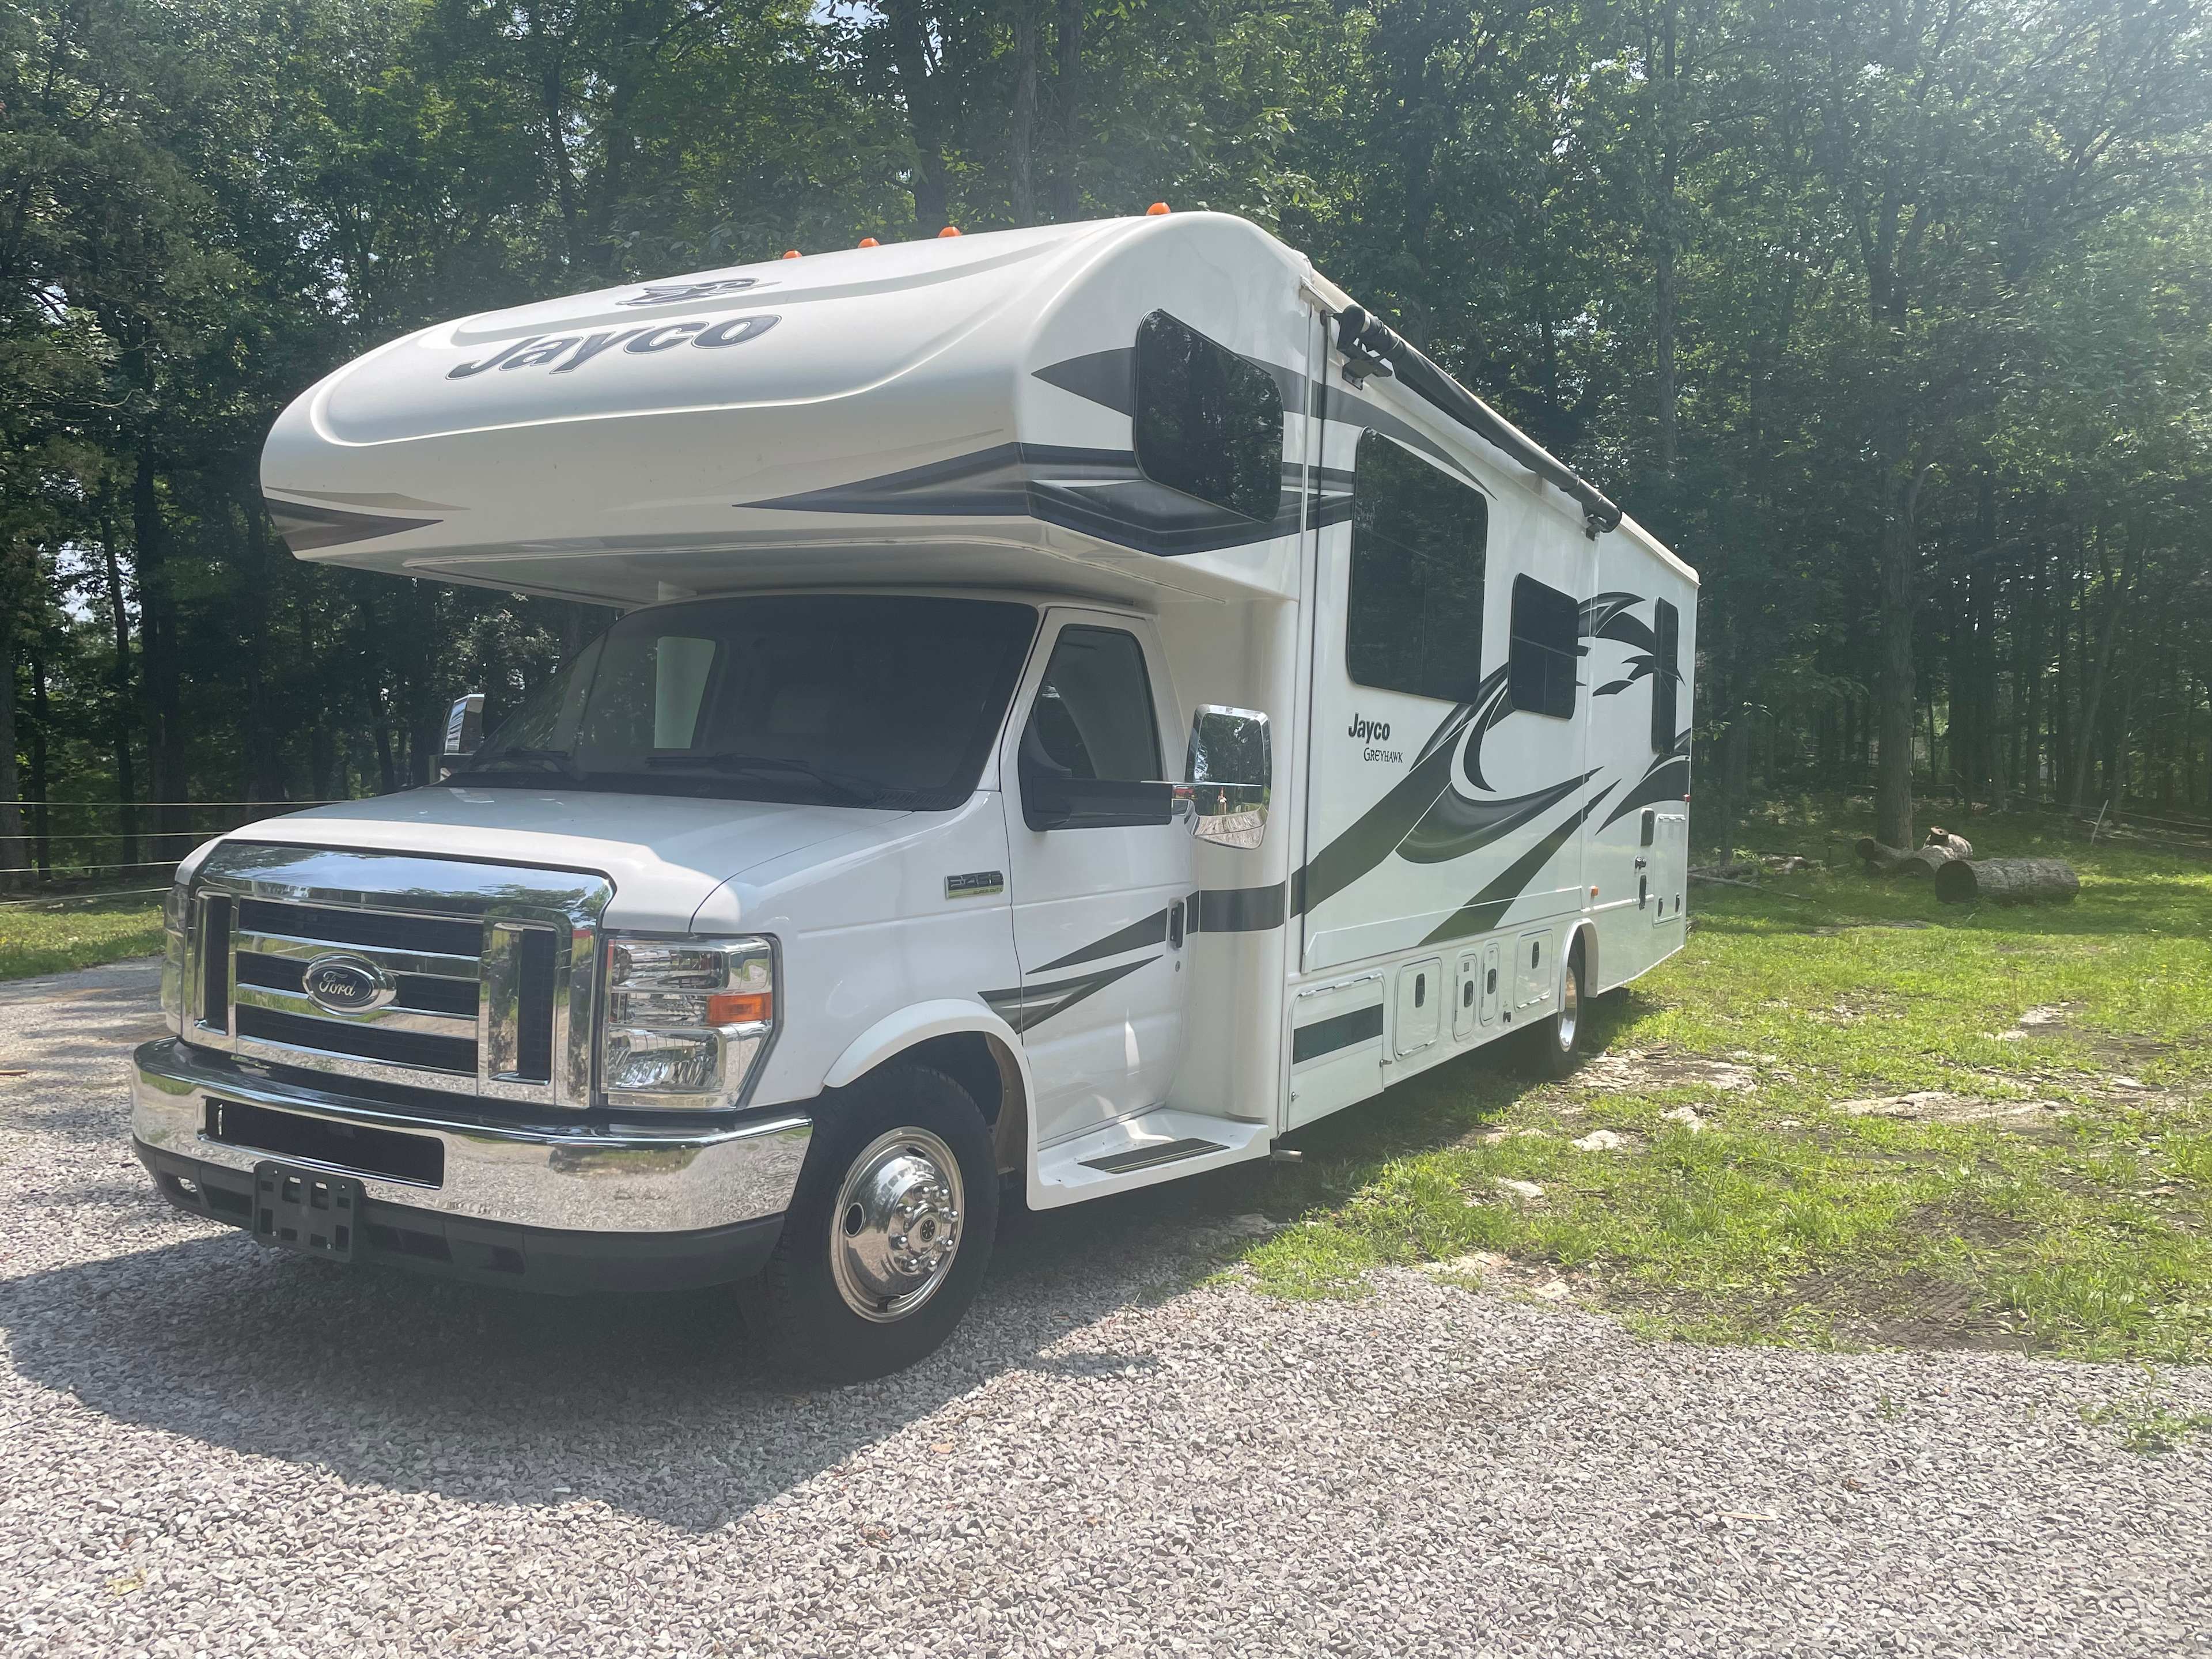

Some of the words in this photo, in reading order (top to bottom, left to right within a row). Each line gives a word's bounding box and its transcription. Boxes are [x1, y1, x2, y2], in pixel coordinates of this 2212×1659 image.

[445, 315, 782, 380] Jayco
[1348, 712, 1391, 744] Jayco
[319, 971, 357, 997] Ford
